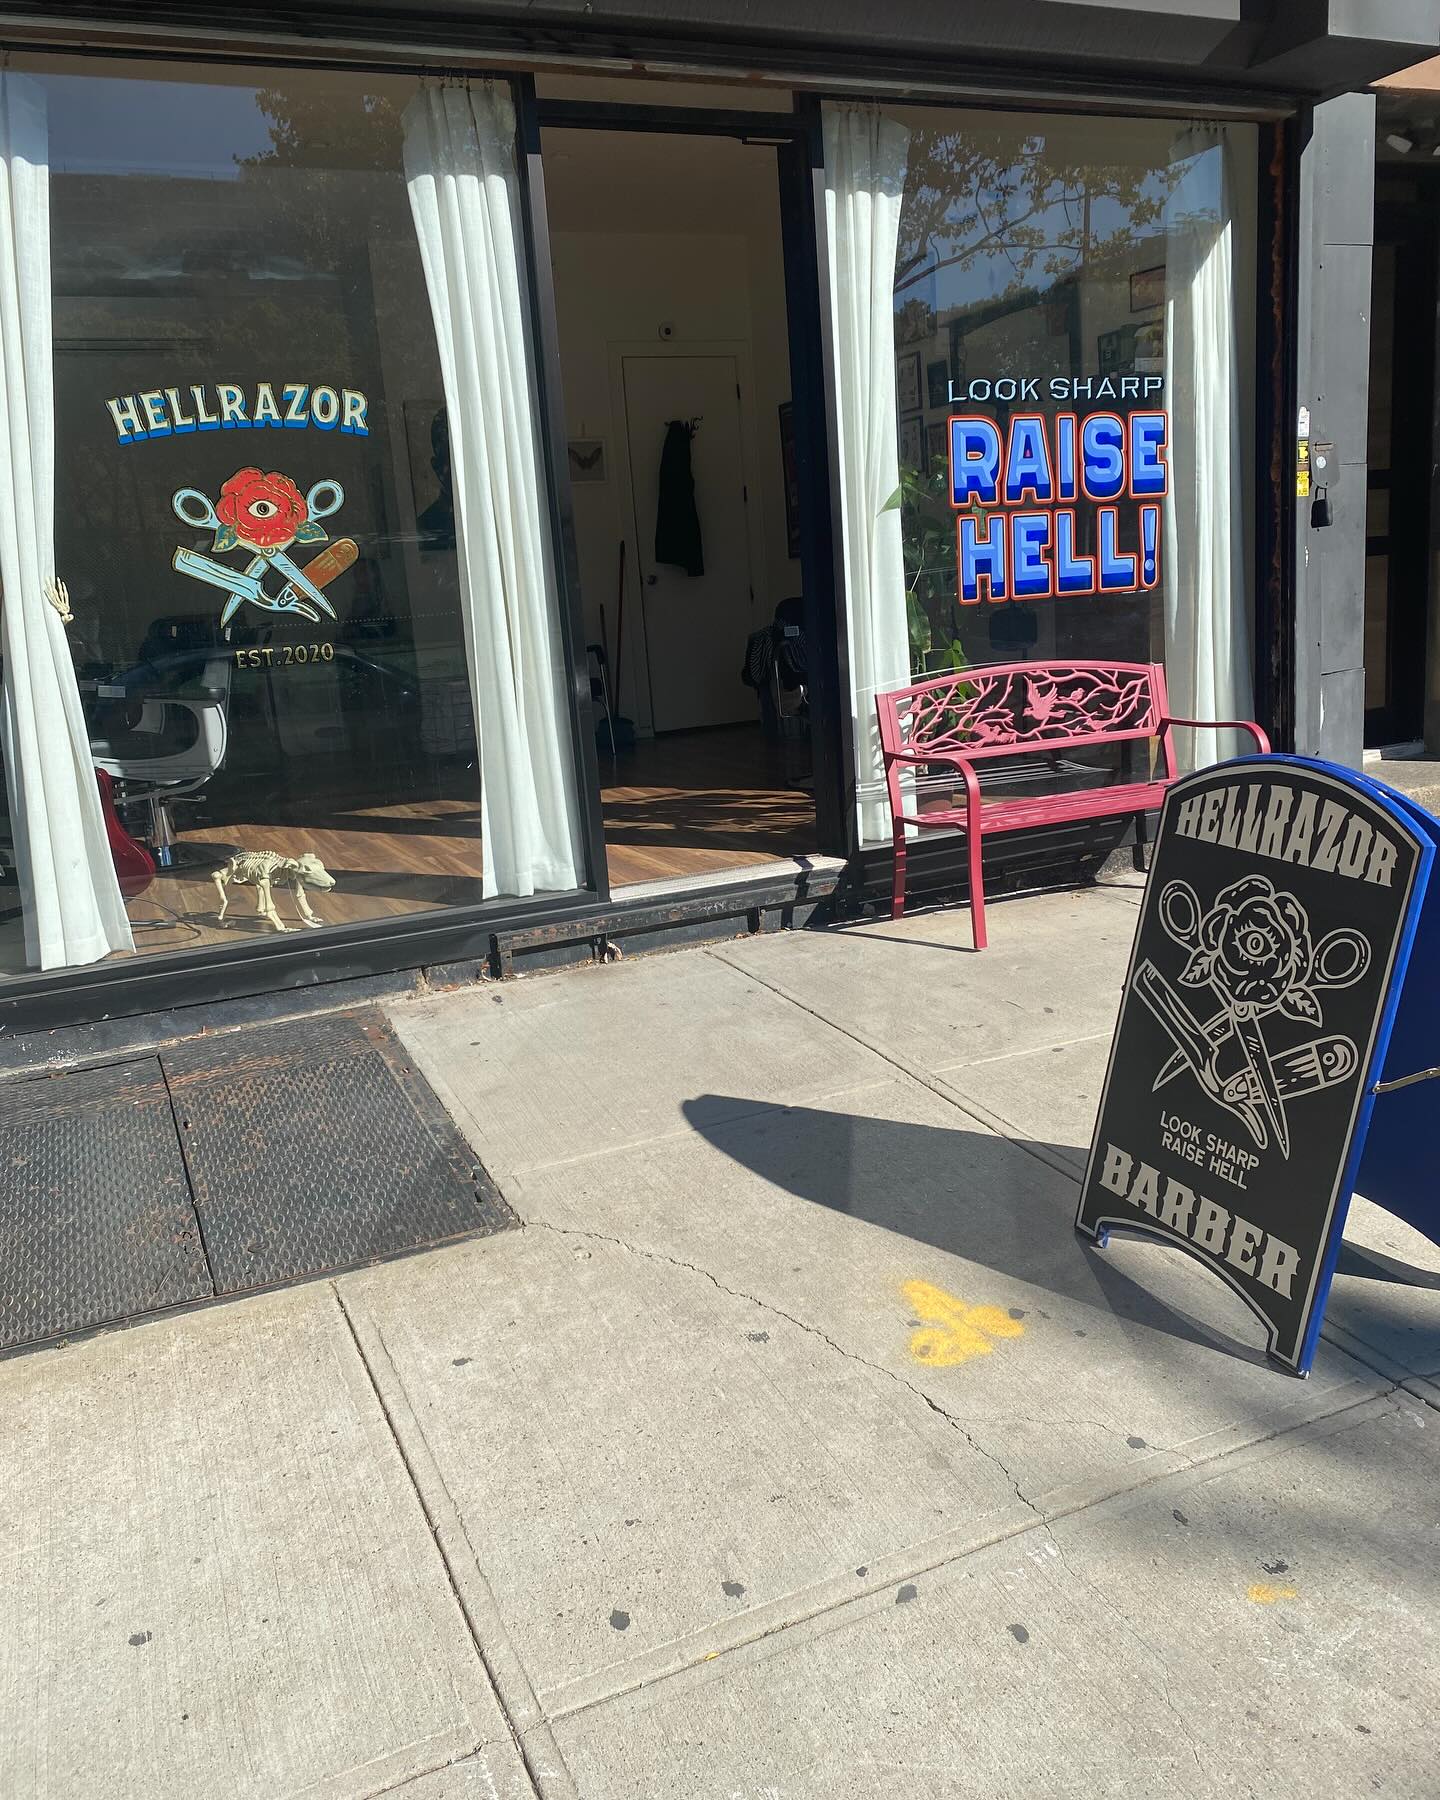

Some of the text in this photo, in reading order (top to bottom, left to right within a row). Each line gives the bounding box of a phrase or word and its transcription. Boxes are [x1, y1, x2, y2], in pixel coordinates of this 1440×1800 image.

[106, 382, 369, 445] HELLRAZOR
[947, 376, 1163, 402] LOOK SHARP
[948, 411, 1167, 507] RAISE
[957, 505, 1160, 604] HELL!
[235, 642, 335, 669] EST.2020
[1176, 784, 1398, 887] HELLRAZOR
[1160, 1110, 1260, 1171] LOOK SHARP
[1161, 1134, 1248, 1190] RAISE HELL
[1099, 1143, 1300, 1300] BARBER
